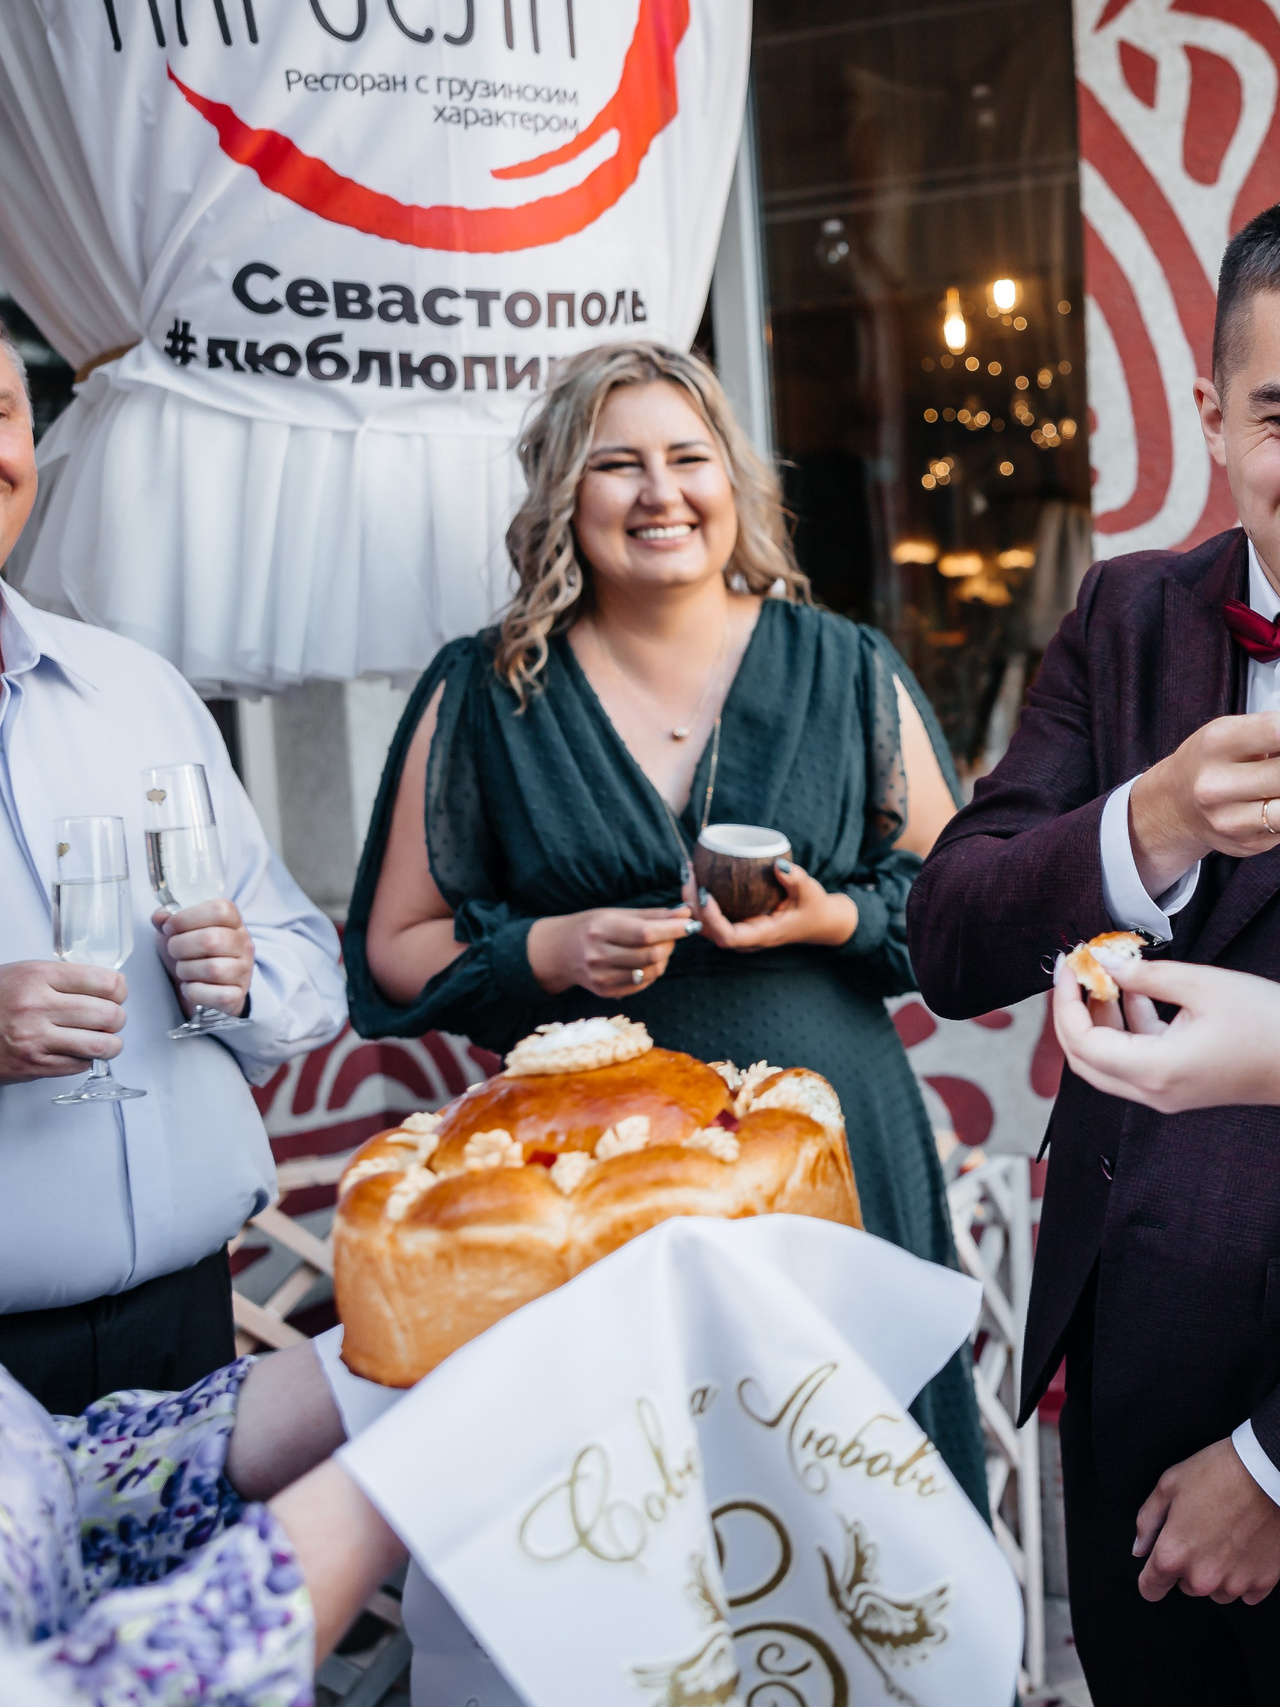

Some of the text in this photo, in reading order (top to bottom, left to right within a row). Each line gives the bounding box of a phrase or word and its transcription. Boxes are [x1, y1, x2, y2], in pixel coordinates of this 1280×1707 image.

[285, 69, 579, 105] Ресторан с грузинским
[433, 104, 579, 133] характером
[231, 261, 647, 328] Севастополь
[164, 317, 557, 391] #люблюпи
